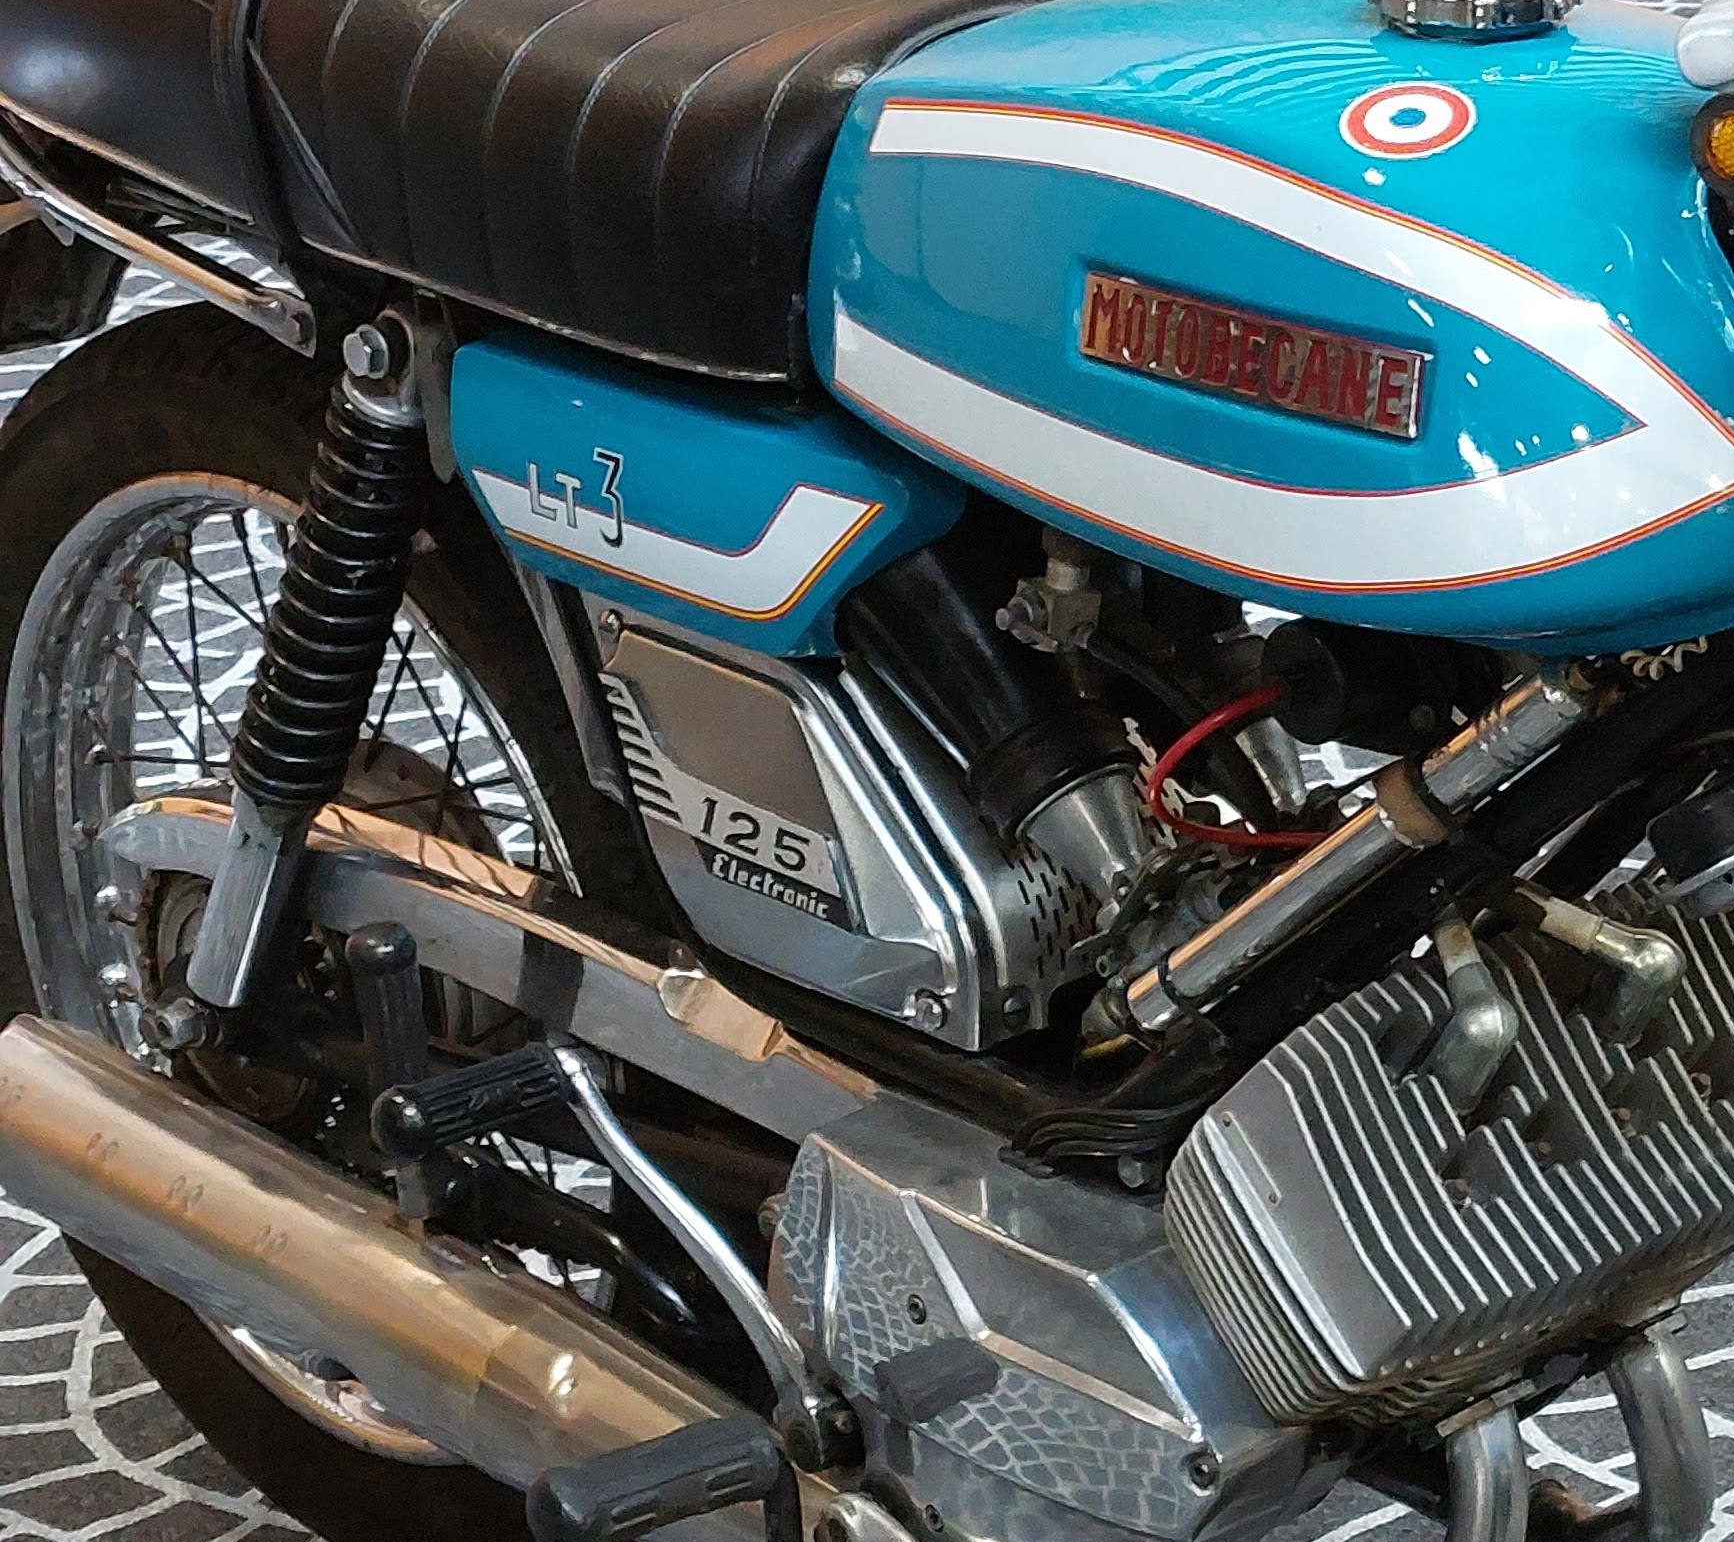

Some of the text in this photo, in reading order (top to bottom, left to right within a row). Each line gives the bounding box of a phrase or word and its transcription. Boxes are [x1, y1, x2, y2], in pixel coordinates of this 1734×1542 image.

[1083, 282, 1410, 428] MOTOBECANE
[700, 796, 810, 872] 125
[711, 852, 829, 919] Electronic
